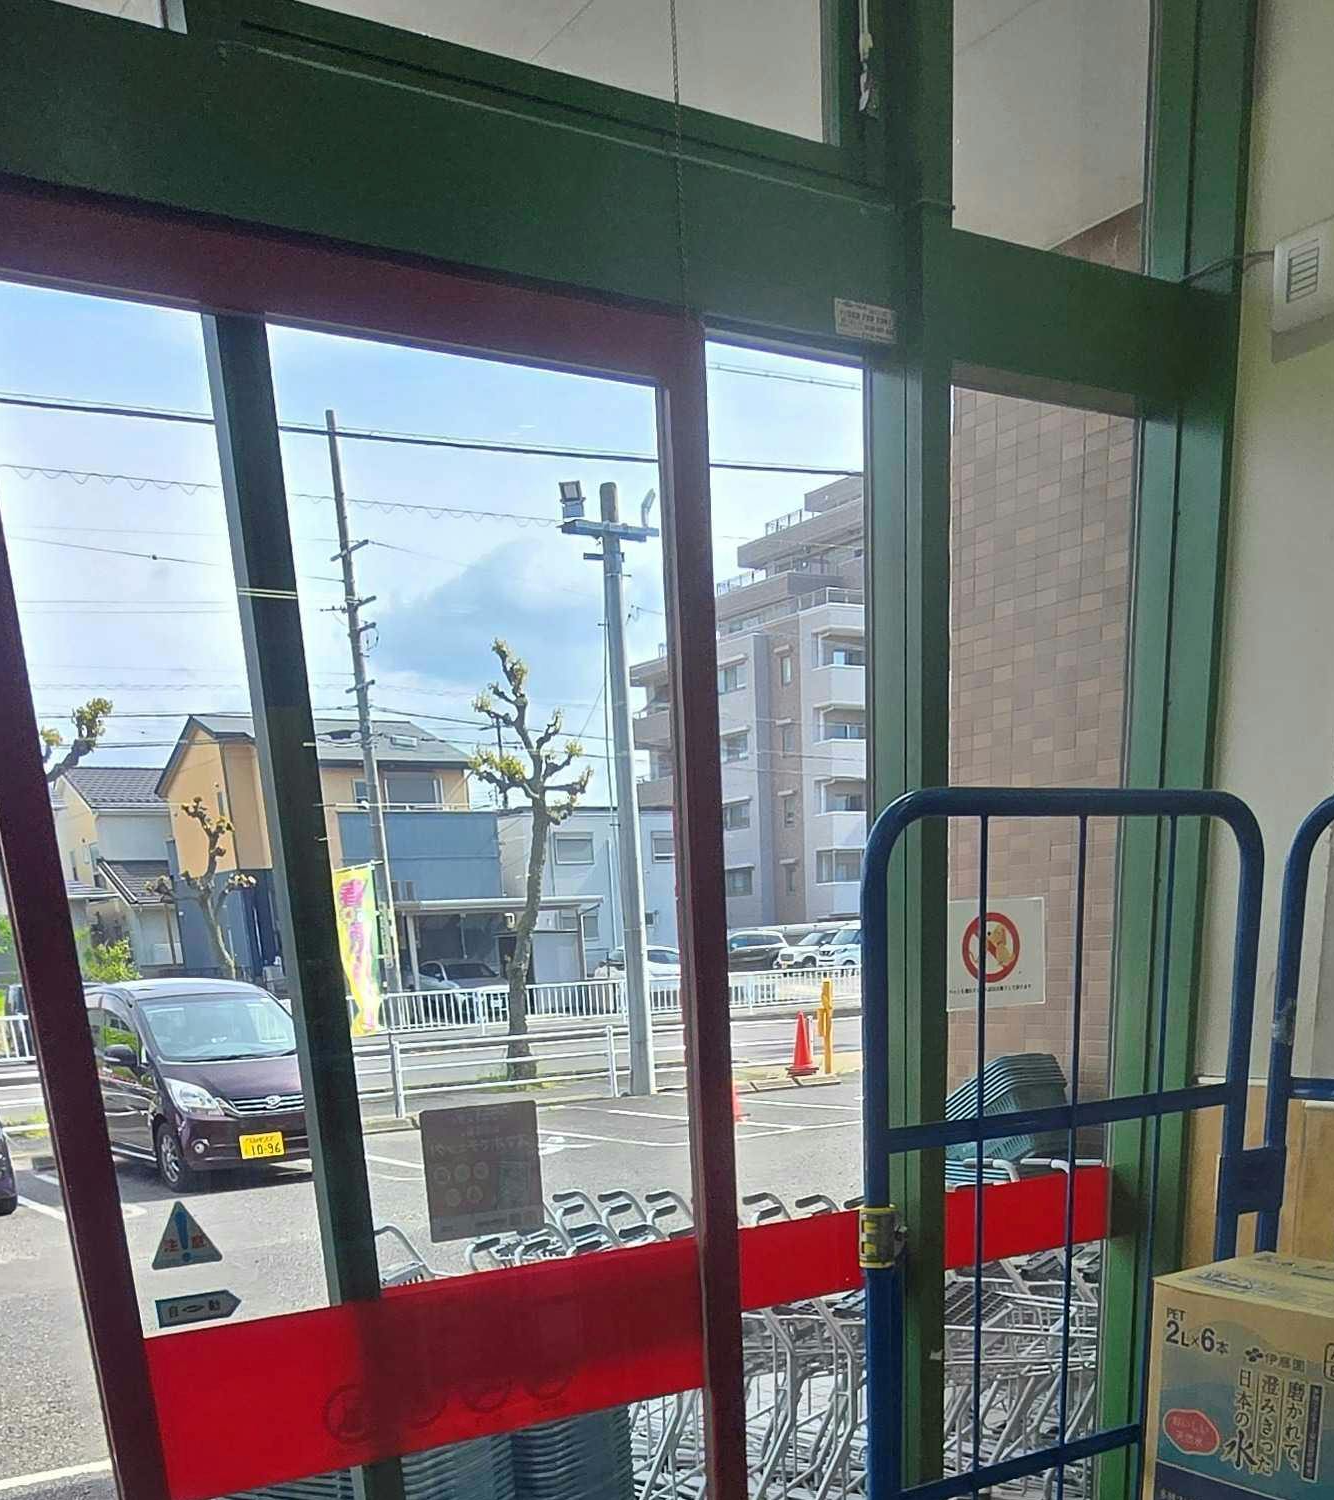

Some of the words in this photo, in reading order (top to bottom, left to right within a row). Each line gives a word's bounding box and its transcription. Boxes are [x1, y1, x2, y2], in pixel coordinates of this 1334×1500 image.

[1166, 1307, 1187, 1321] PET
[1223, 1368, 1259, 1469] 日本の水
